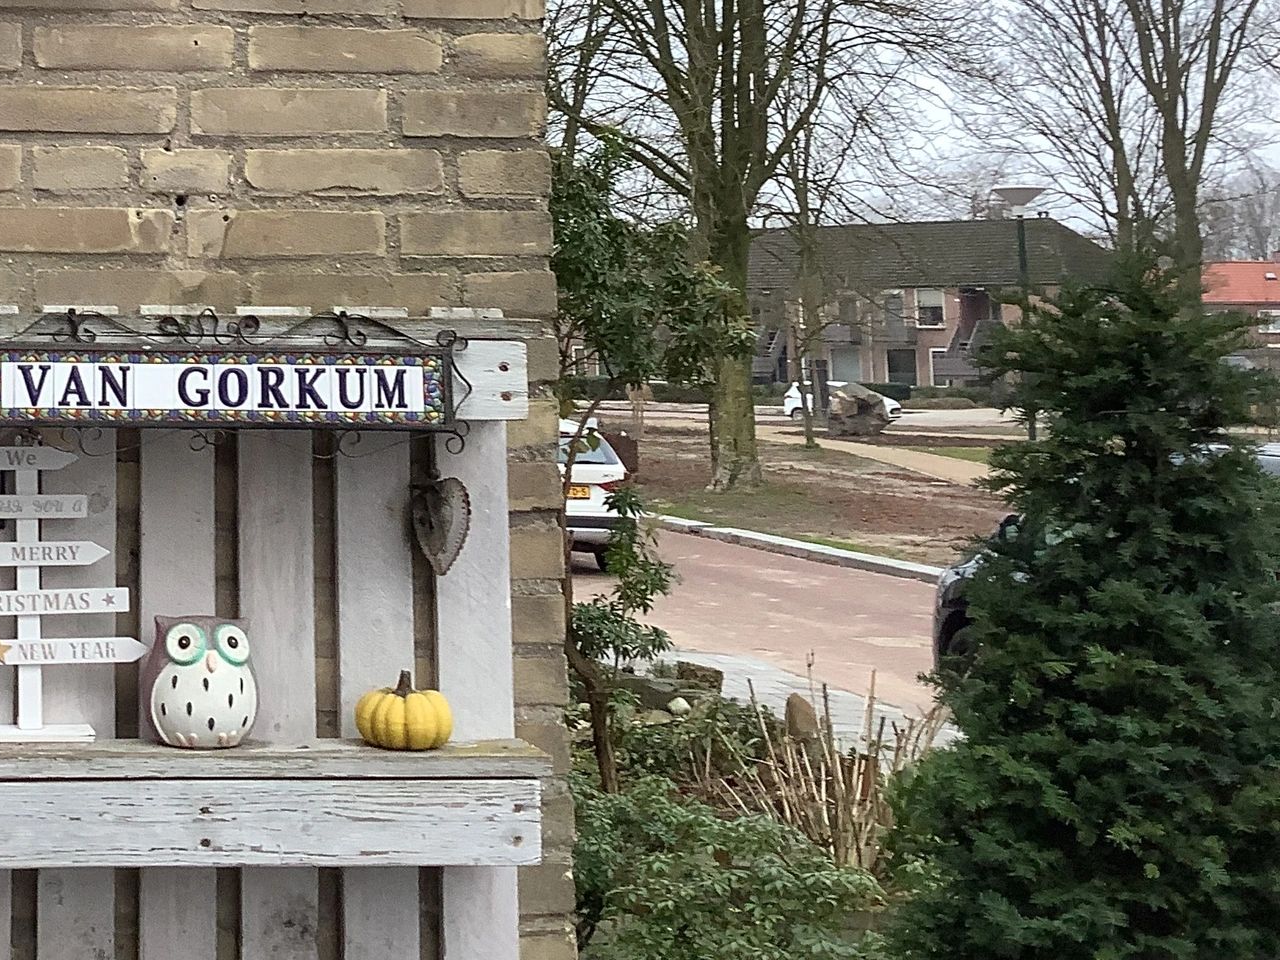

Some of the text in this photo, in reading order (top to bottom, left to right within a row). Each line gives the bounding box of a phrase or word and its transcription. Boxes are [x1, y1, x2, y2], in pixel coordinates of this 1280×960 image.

[17, 364, 410, 410] VAN GORKUM
[5, 449, 37, 466] We
[11, 545, 81, 562] MERRY
[19, 643, 57, 661] NEW
[69, 641, 117, 660] YEAR
